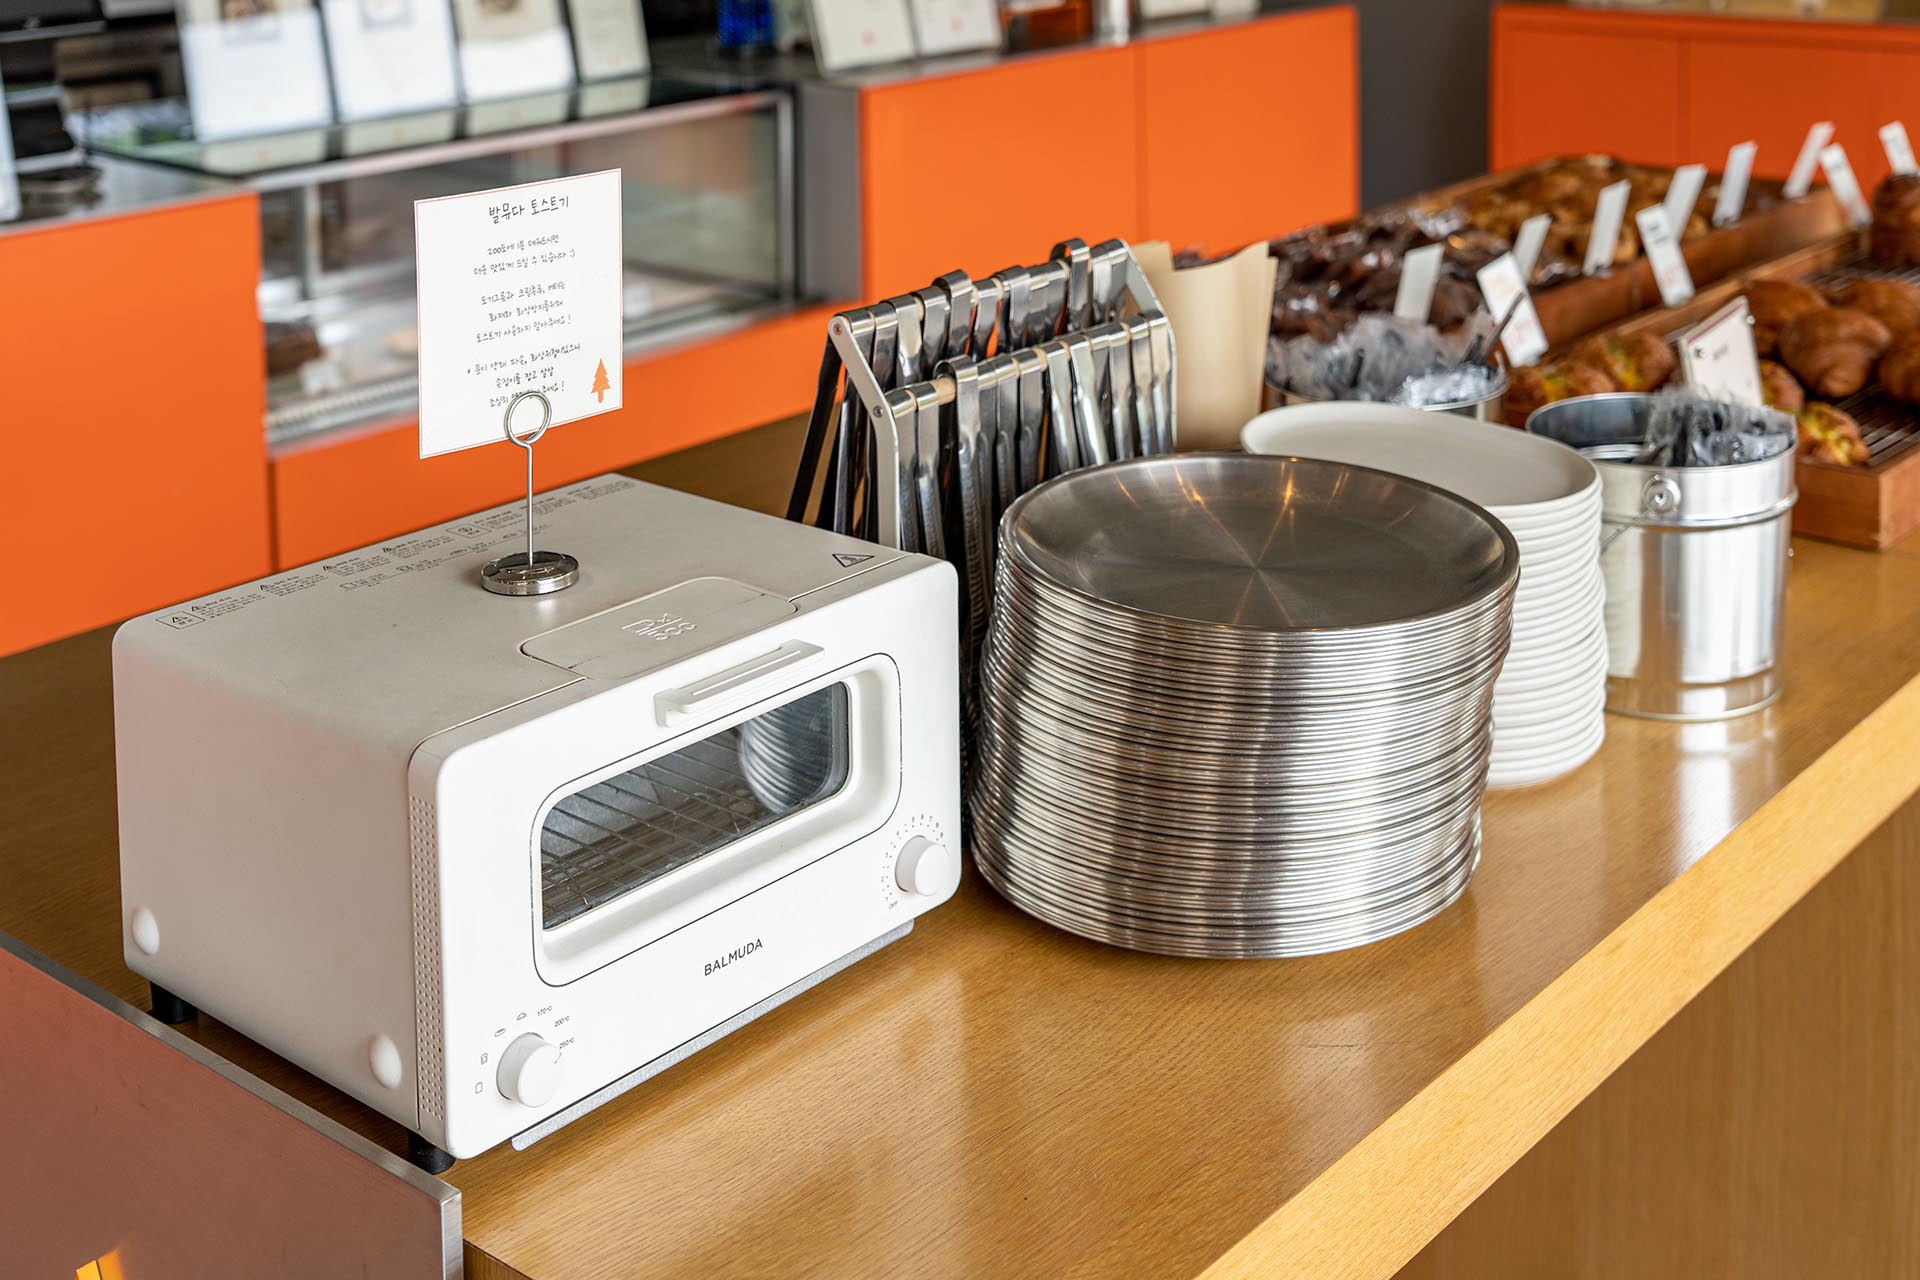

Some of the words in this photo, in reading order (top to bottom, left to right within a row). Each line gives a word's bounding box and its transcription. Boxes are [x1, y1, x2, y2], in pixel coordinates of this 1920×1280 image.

[488, 202, 525, 224] 발뮤다
[531, 196, 569, 215] 토스트기
[488, 243, 515, 255] 200도에
[517, 240, 525, 250] 1분
[528, 234, 559, 247] 데워드시면
[473, 264, 487, 276] 더욱
[490, 261, 515, 273] 맛있게
[517, 257, 529, 268] 드실
[532, 255, 538, 264] 수
[540, 251, 567, 263] 있습니다
[481, 291, 514, 305] 도기그릇과
[518, 284, 545, 298] 크림종류,
[547, 280, 566, 291] 버터는
[488, 310, 513, 322] 화재와
[476, 330, 501, 343] 토스트기
[504, 324, 531, 337] 사용하지
[474, 364, 487, 375] 문이
[491, 360, 507, 371] 약해
[510, 355, 527, 366] 파손,
[495, 372, 521, 388] 손잡이를
[525, 370, 537, 382] 잡고
[540, 366, 554, 378] 살살
[488, 397, 509, 408] 조심히
[704, 938, 763, 976] BALMUDA
